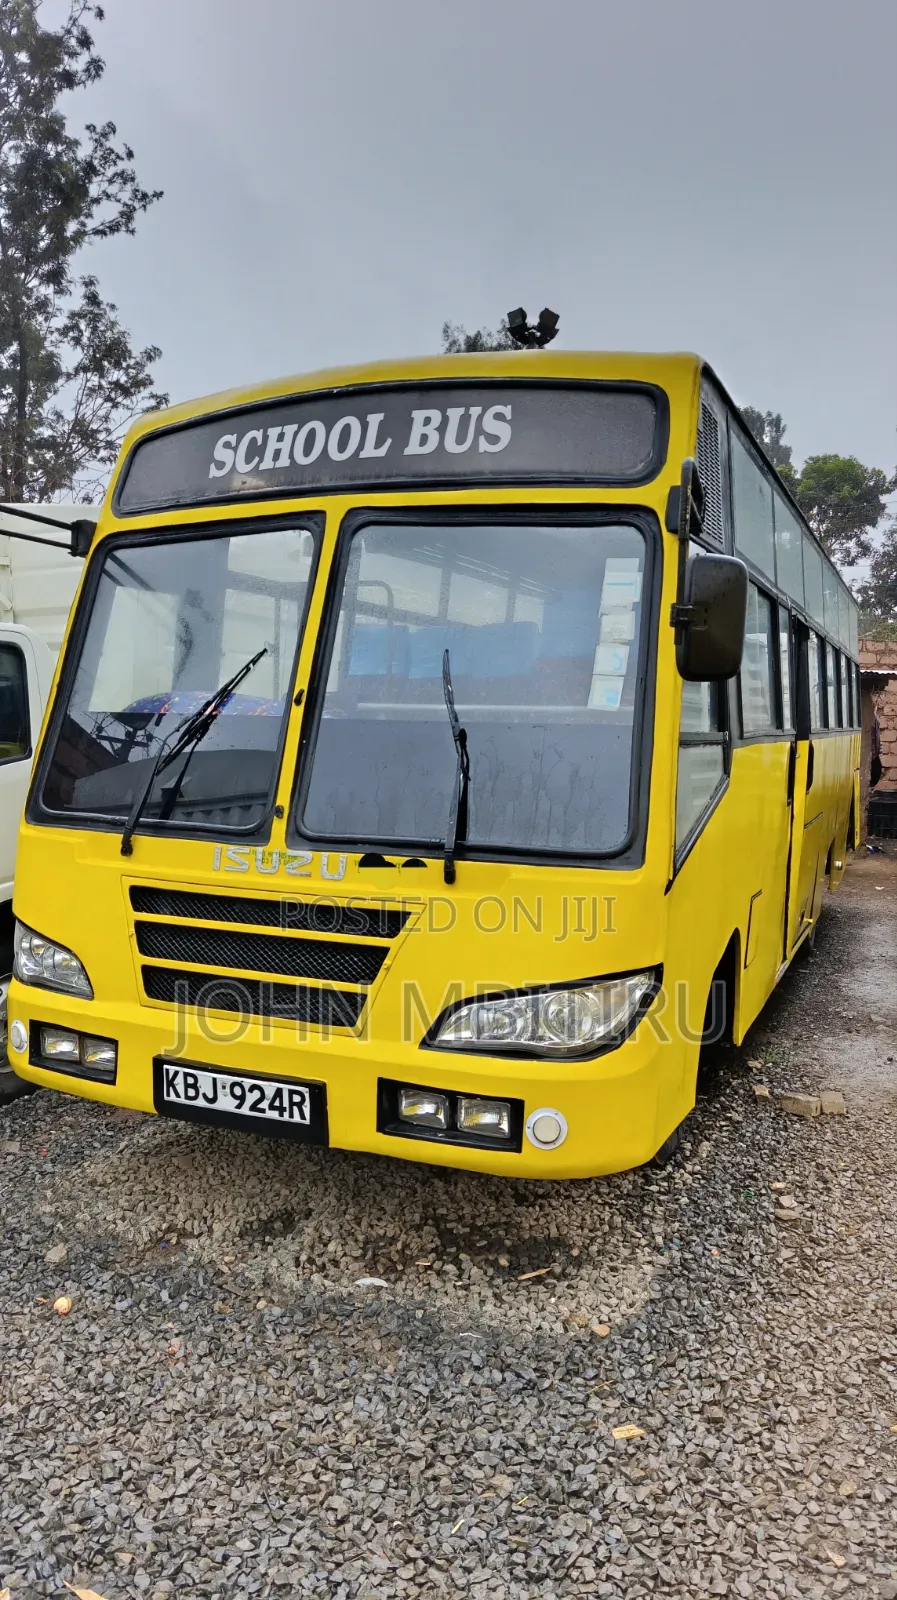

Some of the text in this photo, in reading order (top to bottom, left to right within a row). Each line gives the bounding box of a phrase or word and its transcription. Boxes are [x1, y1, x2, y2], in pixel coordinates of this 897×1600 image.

[208, 405, 513, 478] SCHOOL BUS
[213, 846, 348, 880] ISUZU
[165, 1068, 307, 1121] KBJ 924R
